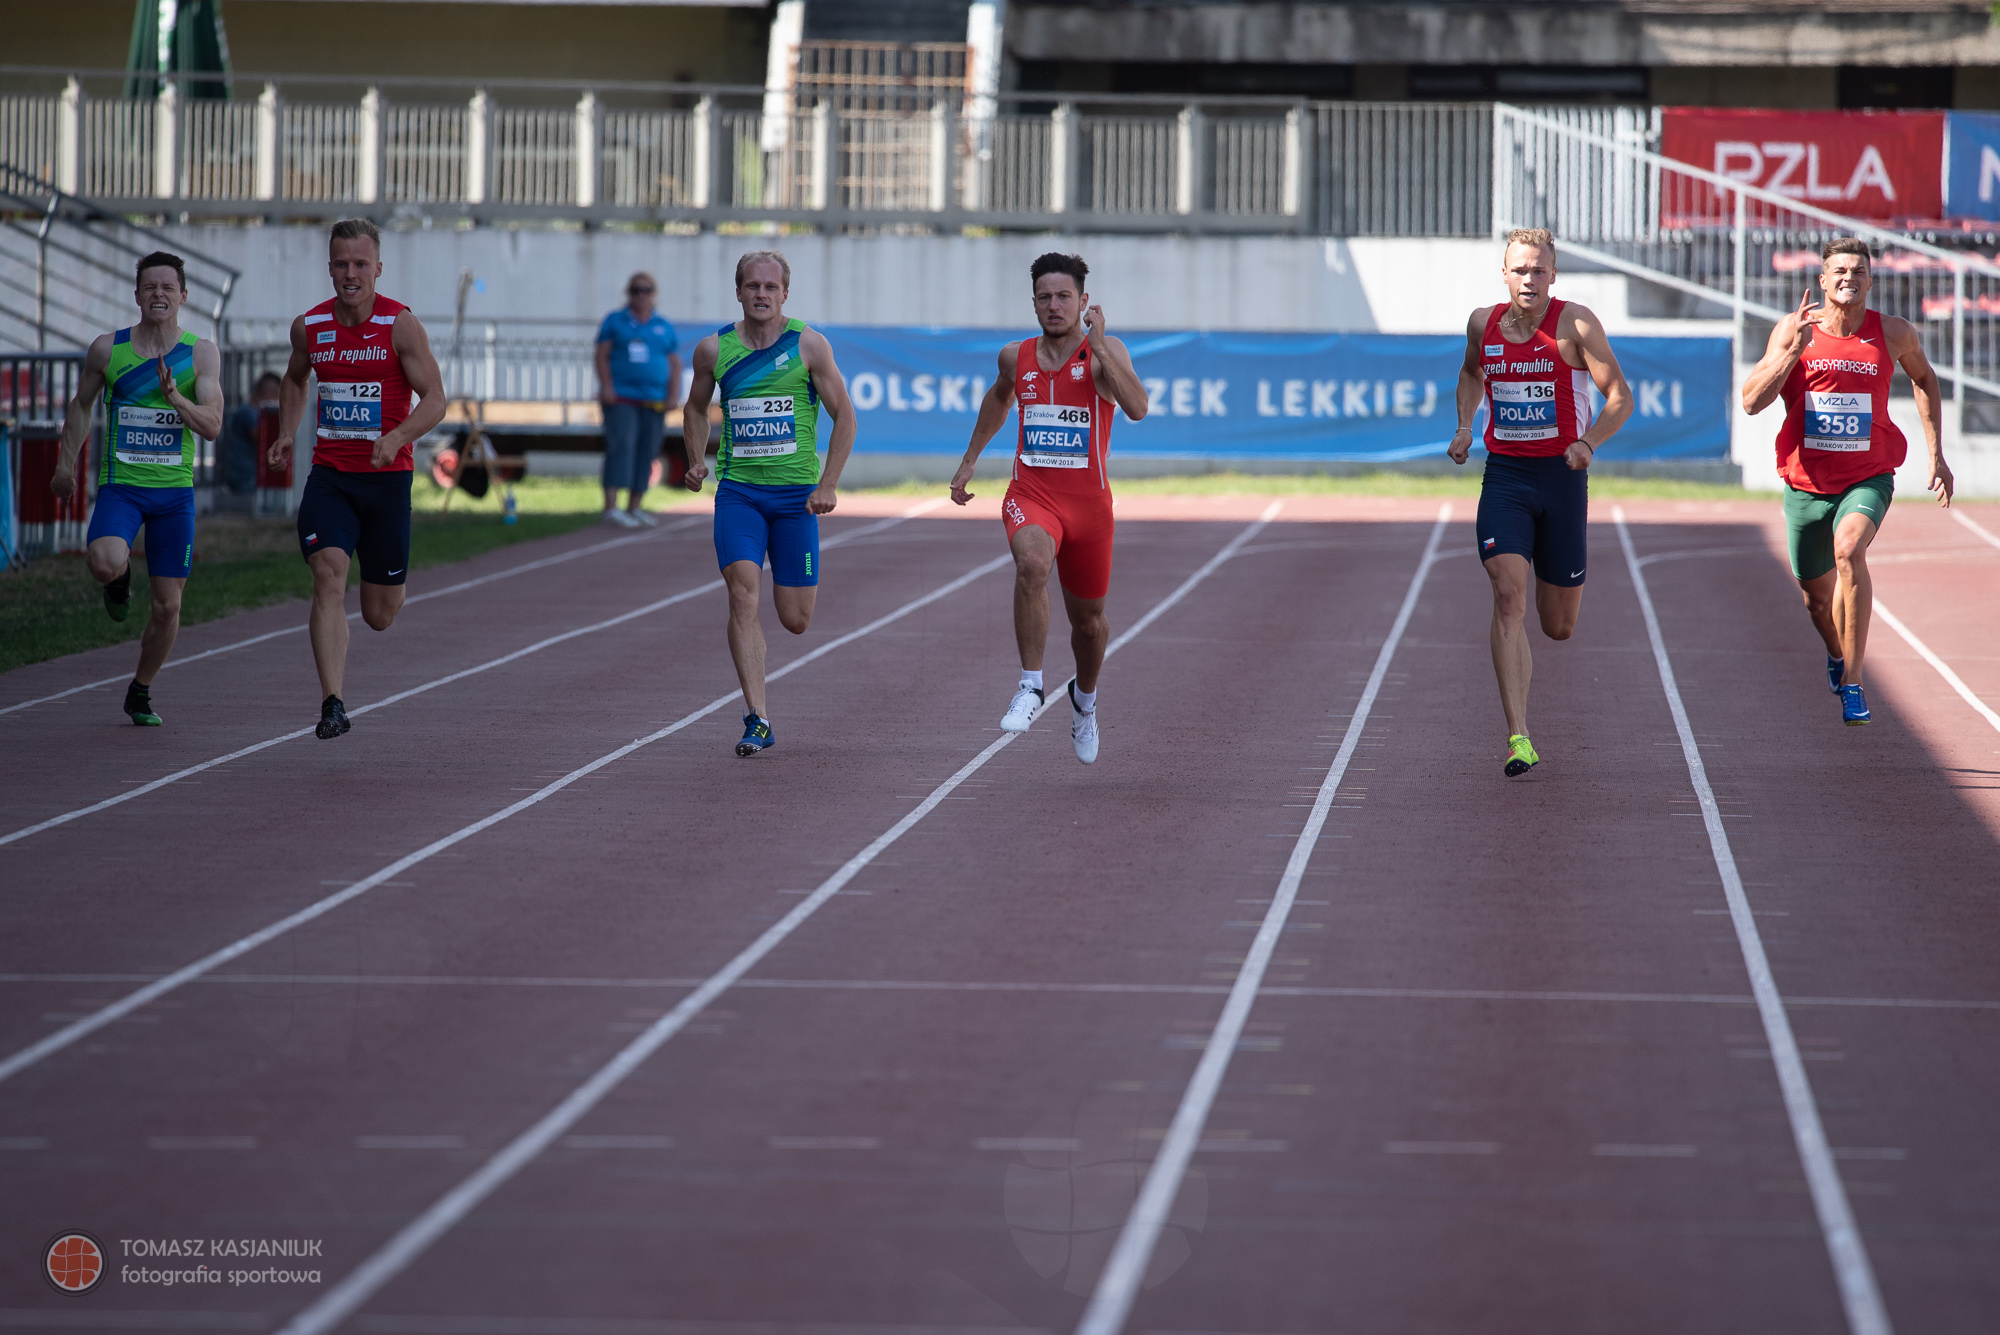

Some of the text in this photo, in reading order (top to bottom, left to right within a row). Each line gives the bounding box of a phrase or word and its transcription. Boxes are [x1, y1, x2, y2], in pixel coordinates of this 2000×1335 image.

[1714, 141, 1897, 202] PZLA
[339, 345, 388, 364] republic
[1510, 358, 1554, 376] republic
[1806, 359, 1878, 376] MAGYARORSZÁG
[350, 384, 381, 398] 122
[843, 372, 986, 413] OLSKI
[1256, 379, 1439, 418] LEKKIEJ
[1524, 385, 1554, 398] 136
[739, 404, 760, 412] Kraków
[763, 400, 793, 413] 232
[1818, 397, 1859, 407] MZLA
[130, 413, 153, 421] Kraków
[155, 412, 184, 425] 203
[325, 404, 371, 422] KOLÁR
[1033, 411, 1055, 419] Kraków
[1057, 409, 1090, 423] 468
[1500, 404, 1546, 421] POLÁK
[734, 420, 791, 438] MOŽINA
[1817, 414, 1860, 435] 358
[126, 431, 174, 447] BENKO
[1026, 430, 1083, 448] WESELA
[1504, 431, 1529, 439] KRAKÓW
[770, 446, 785, 454] 2018
[128, 455, 155, 463] KRAKÓW
